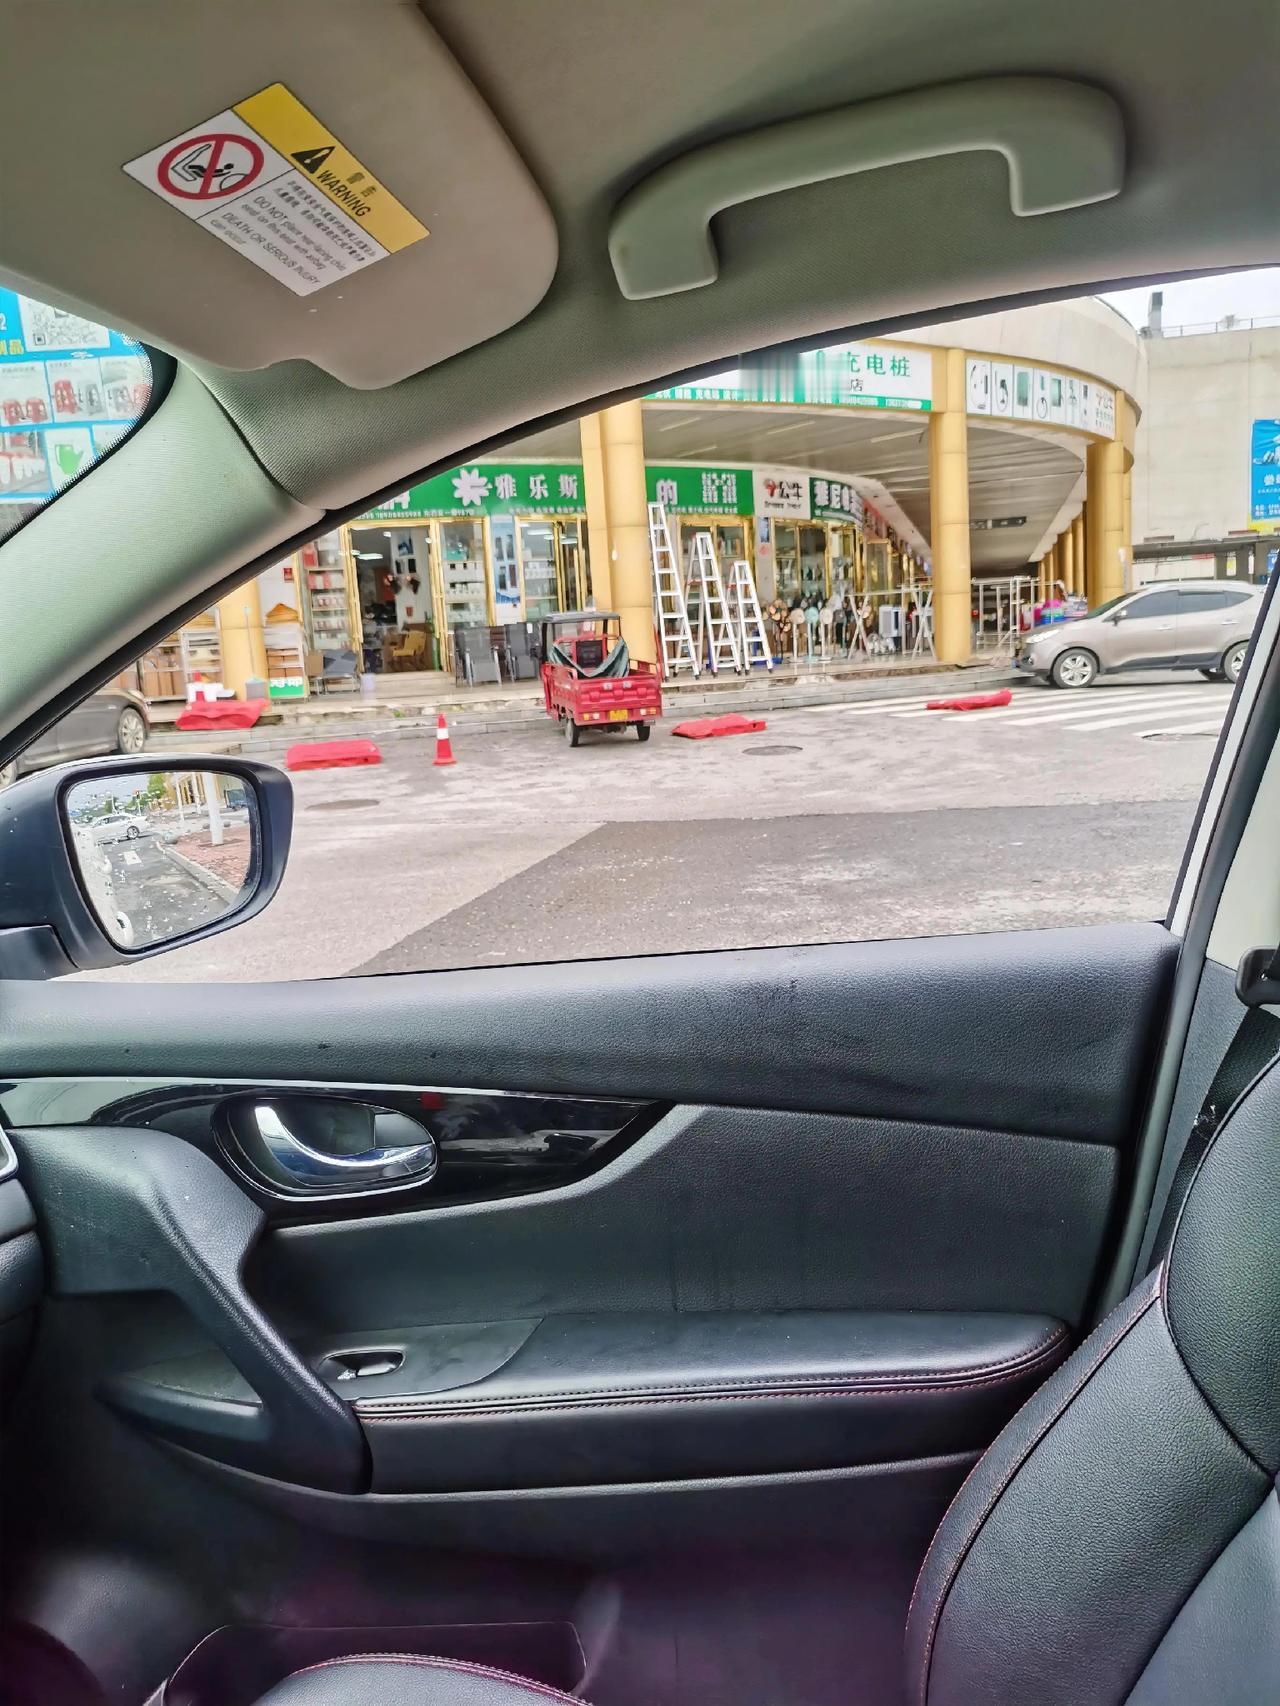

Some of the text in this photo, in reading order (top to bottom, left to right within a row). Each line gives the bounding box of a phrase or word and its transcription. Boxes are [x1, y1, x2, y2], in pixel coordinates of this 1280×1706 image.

[253, 195, 270, 208] DO
[269, 207, 288, 222] NOT
[317, 170, 371, 217] WARNING
[221, 212, 251, 234] DEATH
[250, 231, 266, 245] OR
[263, 242, 297, 268] SERIOUS
[495, 473, 579, 501] 雅乐斯
